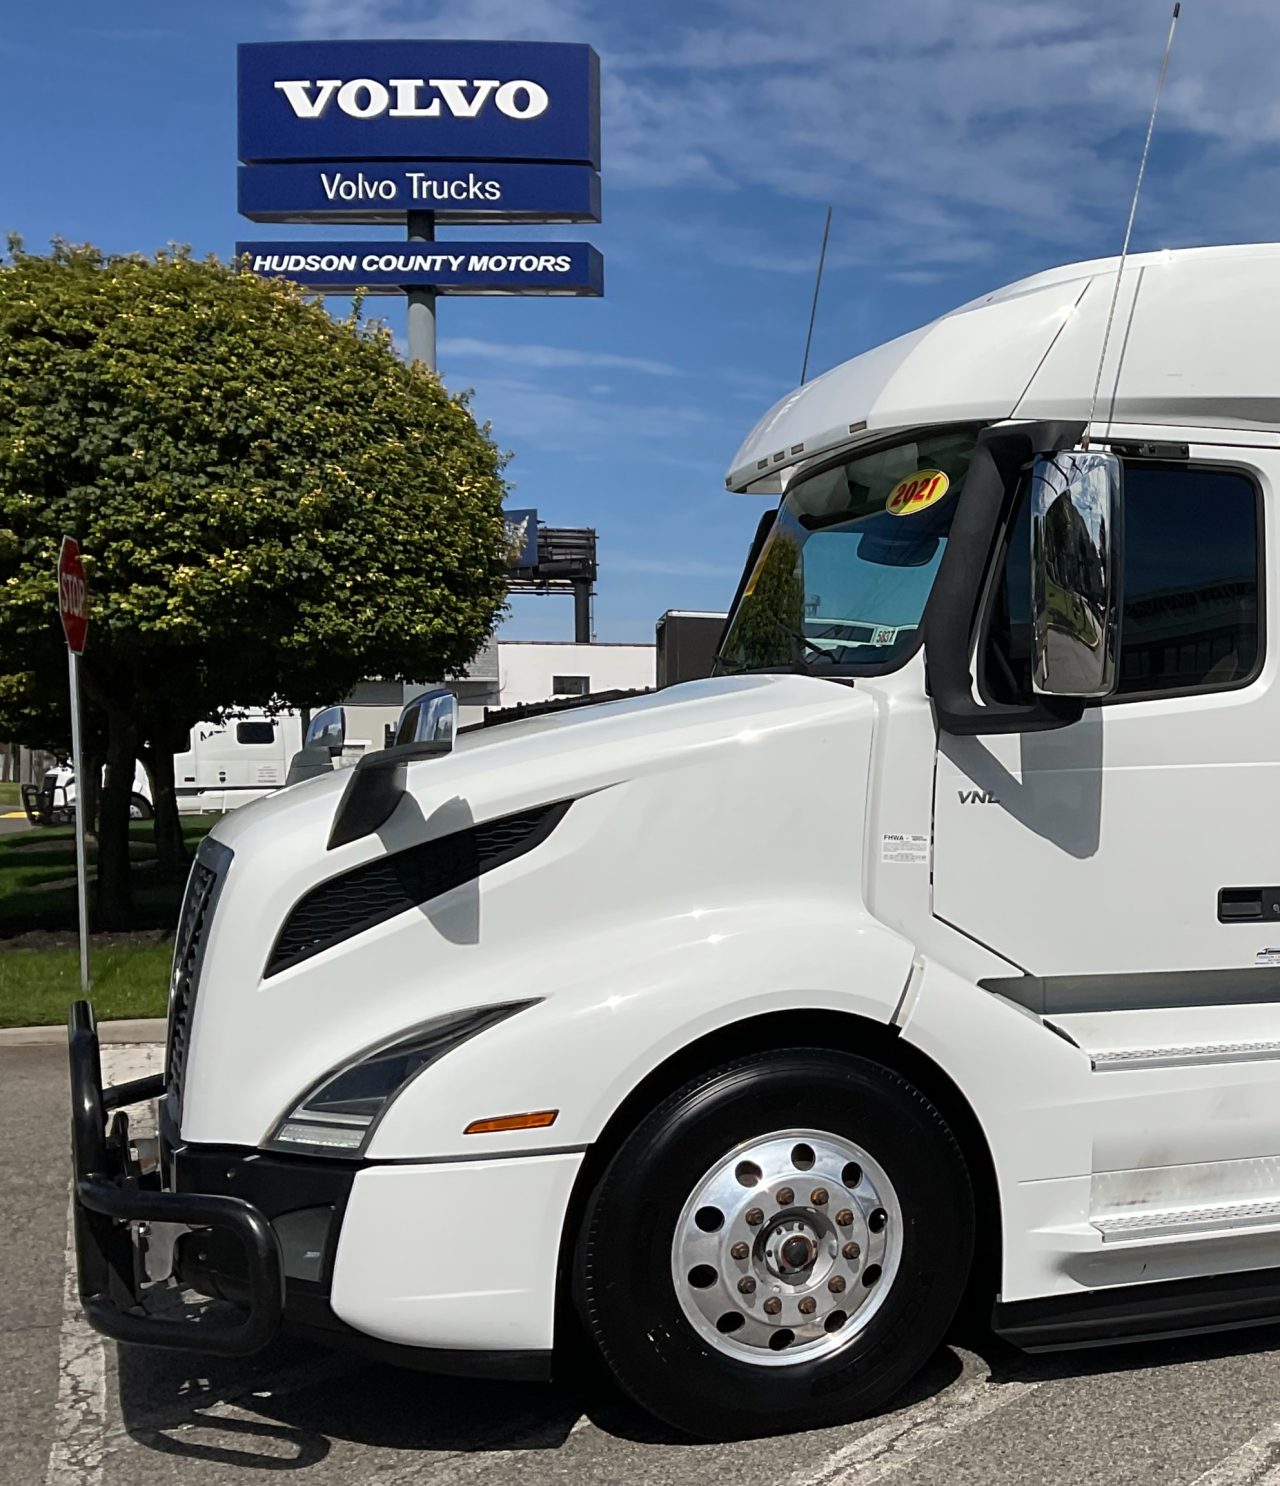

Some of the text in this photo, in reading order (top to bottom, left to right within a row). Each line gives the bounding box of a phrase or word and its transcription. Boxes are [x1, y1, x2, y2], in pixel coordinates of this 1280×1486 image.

[274, 78, 549, 119] VOLVO
[320, 172, 501, 200] Volvo Trucks
[253, 255, 571, 272] HUDSON COUNTY MOTORS
[890, 476, 942, 507] 2021
[62, 572, 85, 617] STOP
[957, 790, 1001, 805] VNL
